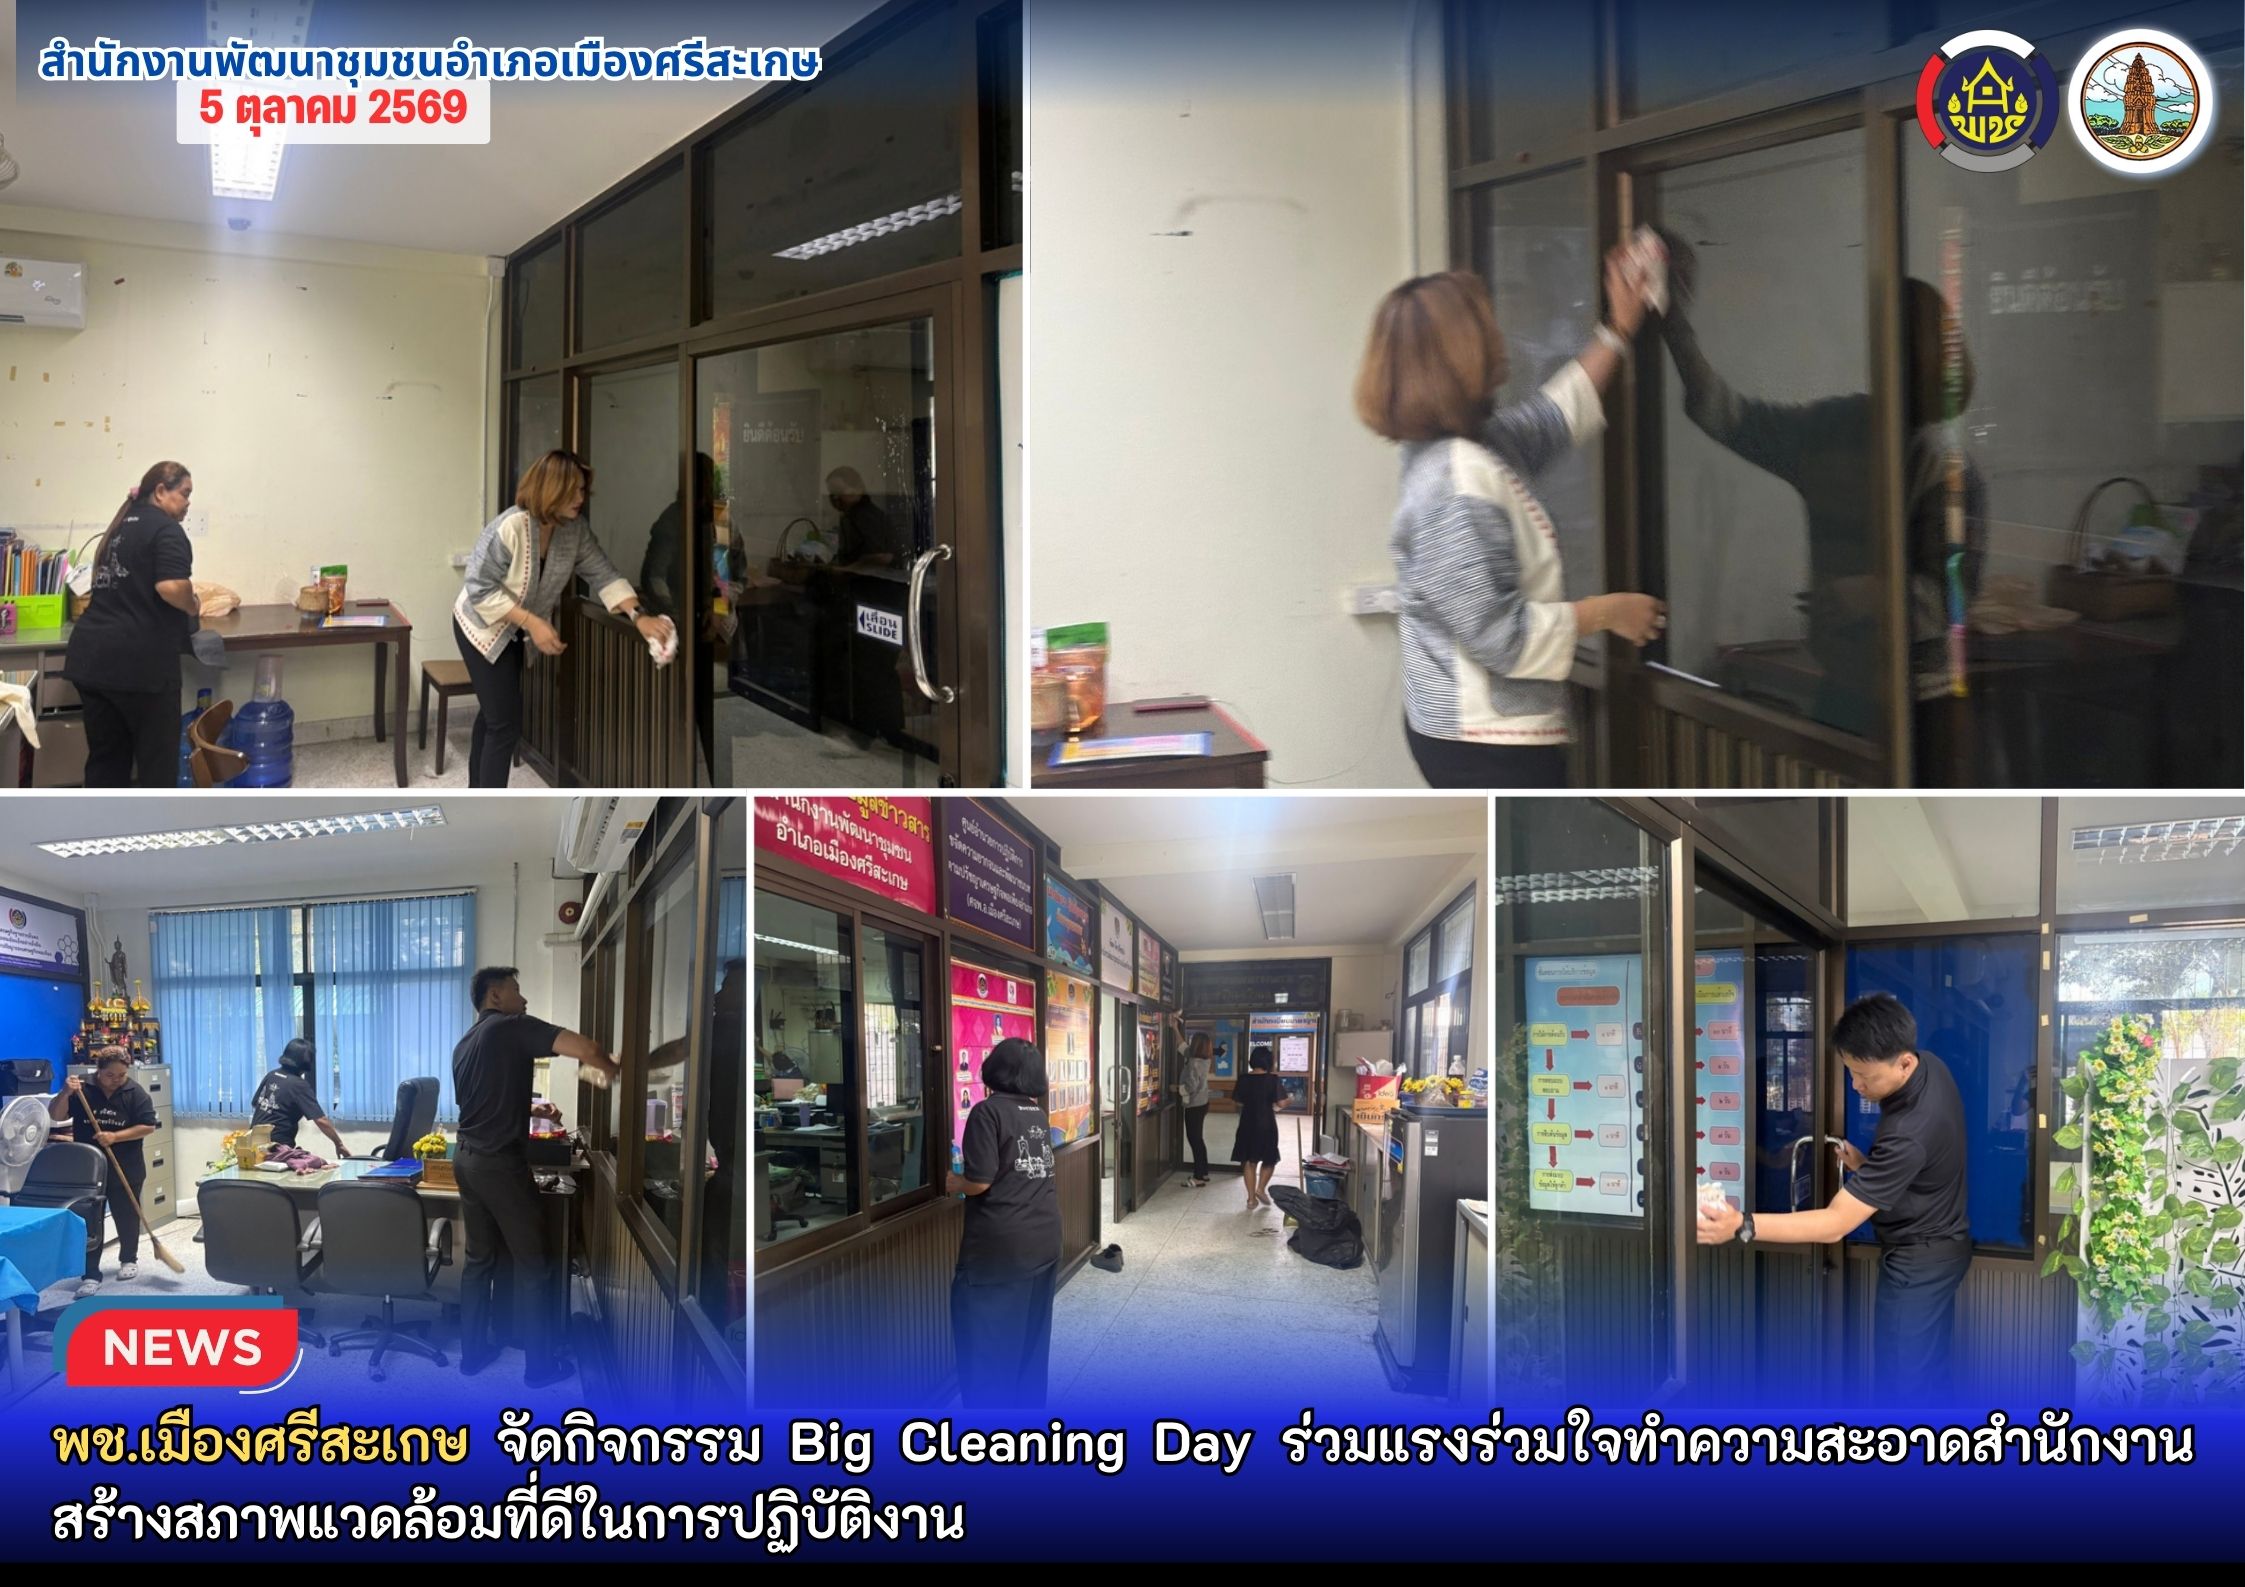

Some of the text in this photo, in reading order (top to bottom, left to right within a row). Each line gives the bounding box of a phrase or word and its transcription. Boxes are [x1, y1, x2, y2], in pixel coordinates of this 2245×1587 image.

[867, 623, 897, 640] SLIDE
[776, 816, 909, 891] อำเภอเมืองศรีสะเกษ
